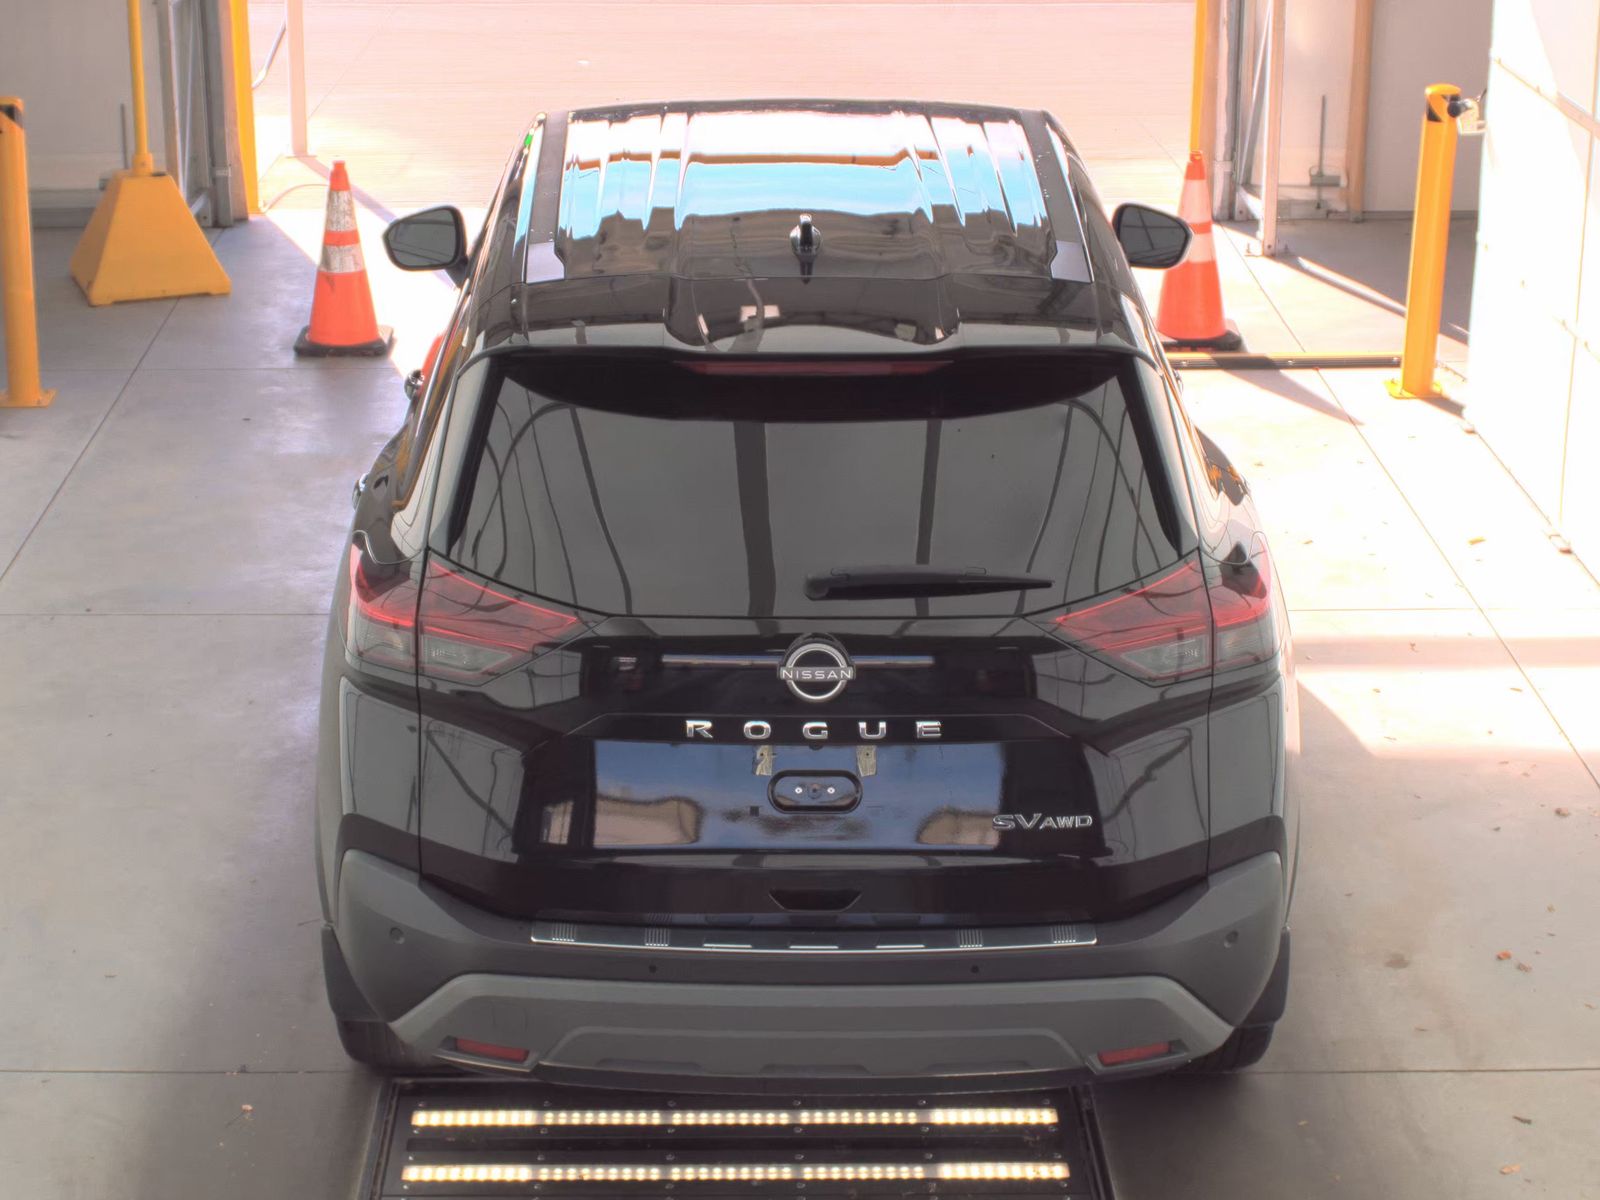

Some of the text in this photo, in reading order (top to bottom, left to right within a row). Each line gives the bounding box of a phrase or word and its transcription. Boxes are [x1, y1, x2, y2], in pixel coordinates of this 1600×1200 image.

[781, 669, 852, 680] NISSAN
[685, 719, 942, 740] ROGUE
[992, 813, 1092, 829] SV AWD
